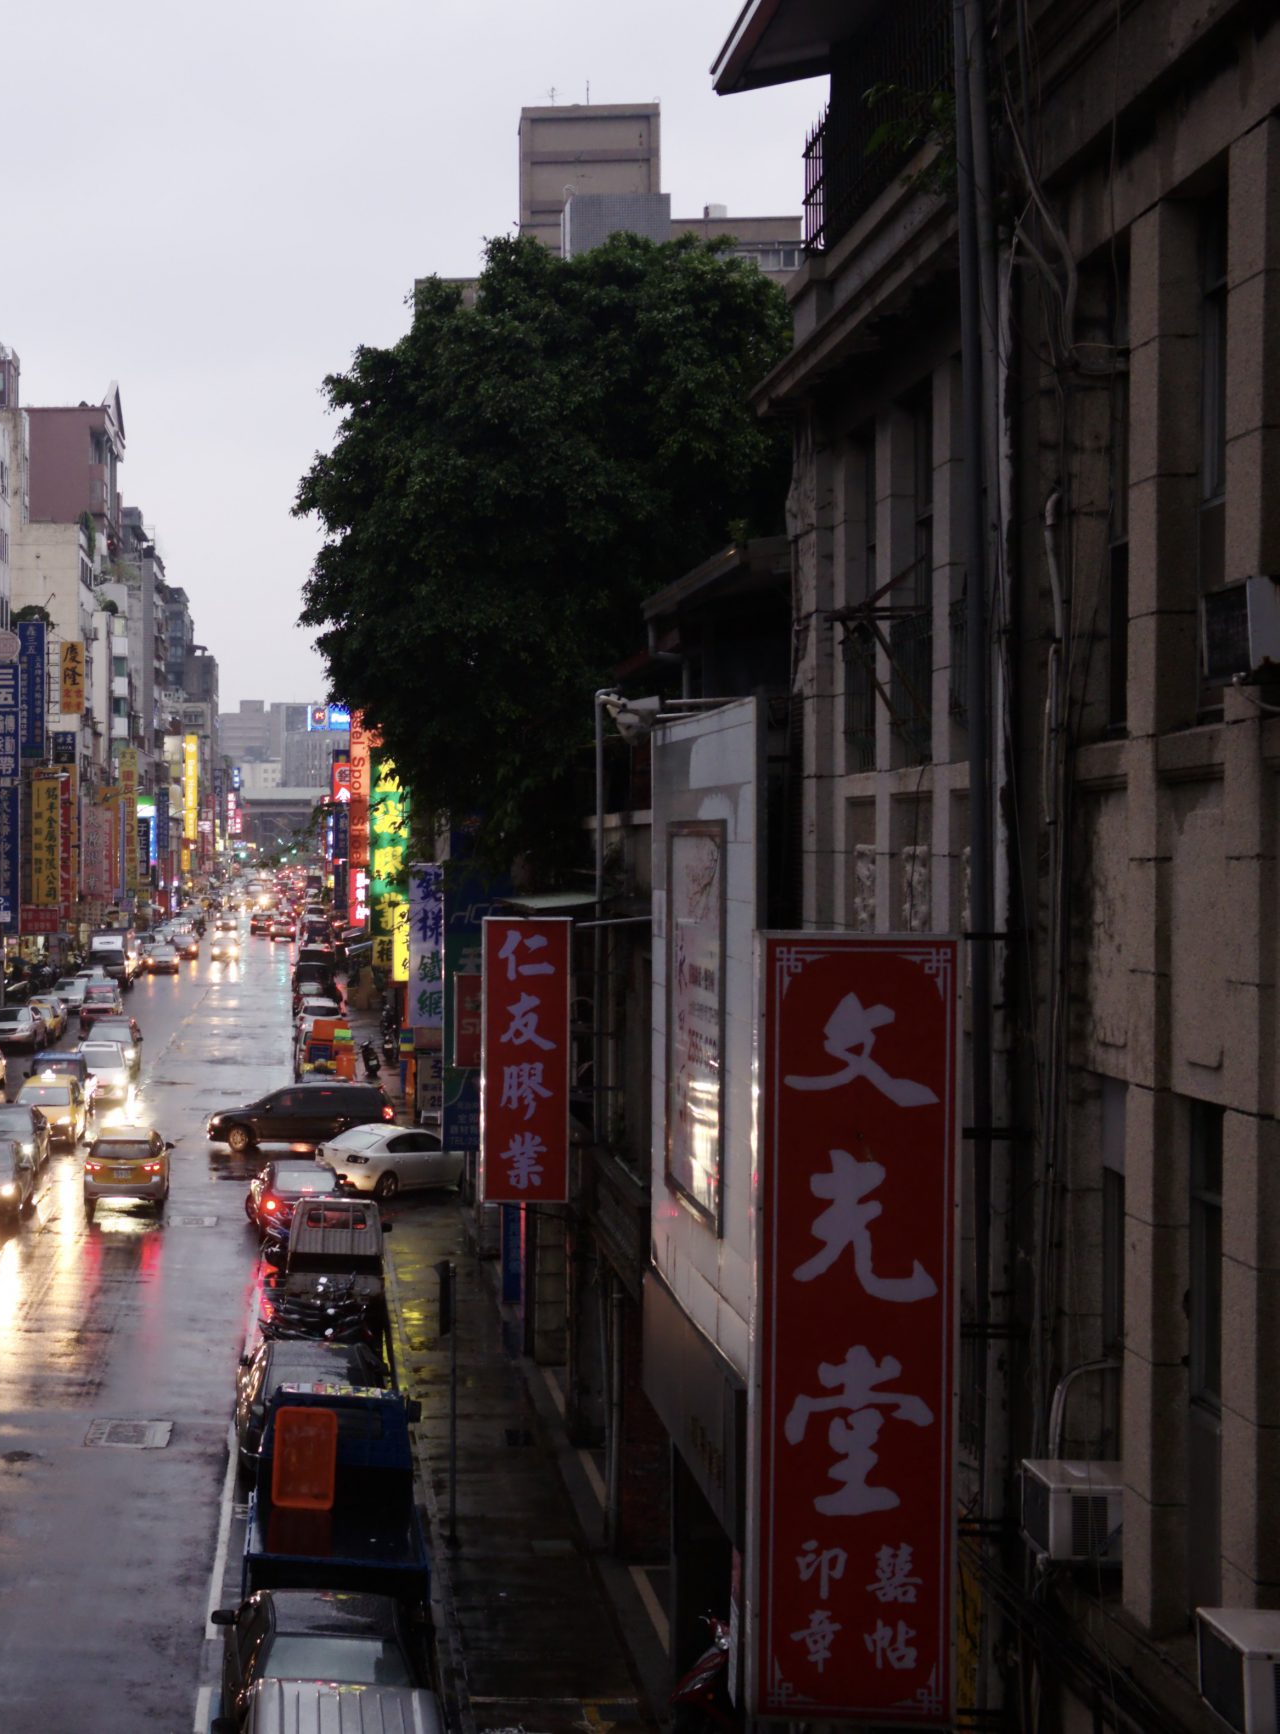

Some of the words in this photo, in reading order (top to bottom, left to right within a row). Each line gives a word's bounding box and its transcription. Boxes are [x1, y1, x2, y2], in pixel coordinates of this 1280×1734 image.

[497, 928, 556, 1191] 仁友膠業
[783, 991, 940, 1518] 文光堂
[790, 1539, 848, 1674] 印章
[864, 1542, 924, 1670] 囍帖
